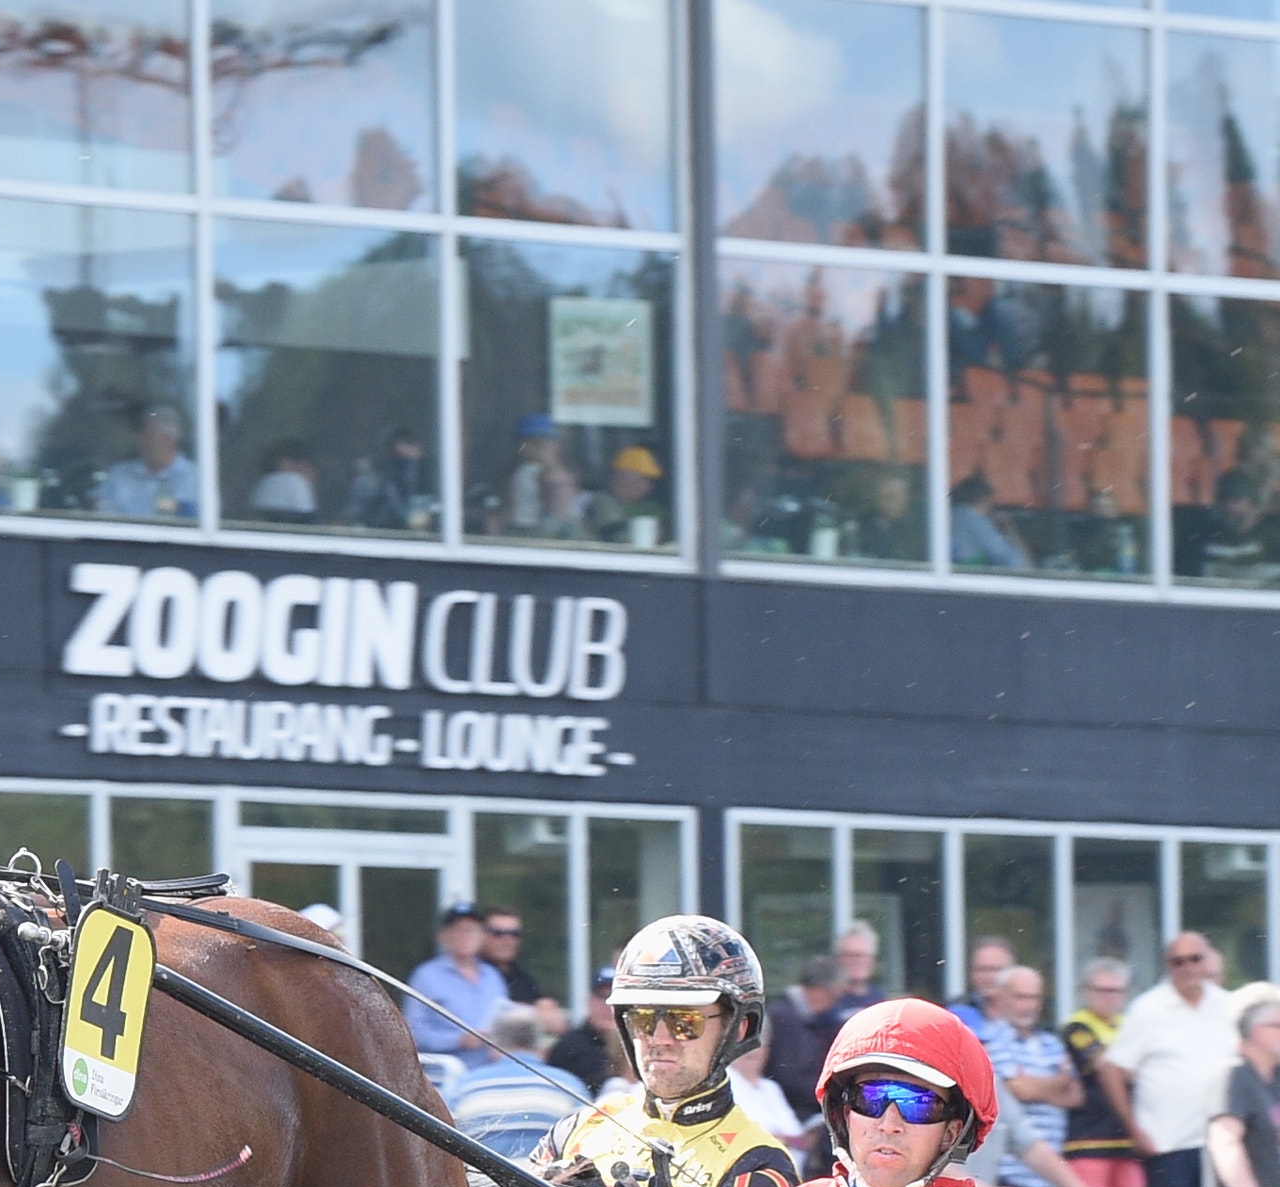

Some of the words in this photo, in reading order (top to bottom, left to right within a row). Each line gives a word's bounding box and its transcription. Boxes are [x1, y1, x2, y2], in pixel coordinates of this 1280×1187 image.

[62, 562, 418, 690] ZOOGIN
[423, 589, 628, 702] CLUB
[79, 925, 134, 1061] 4
